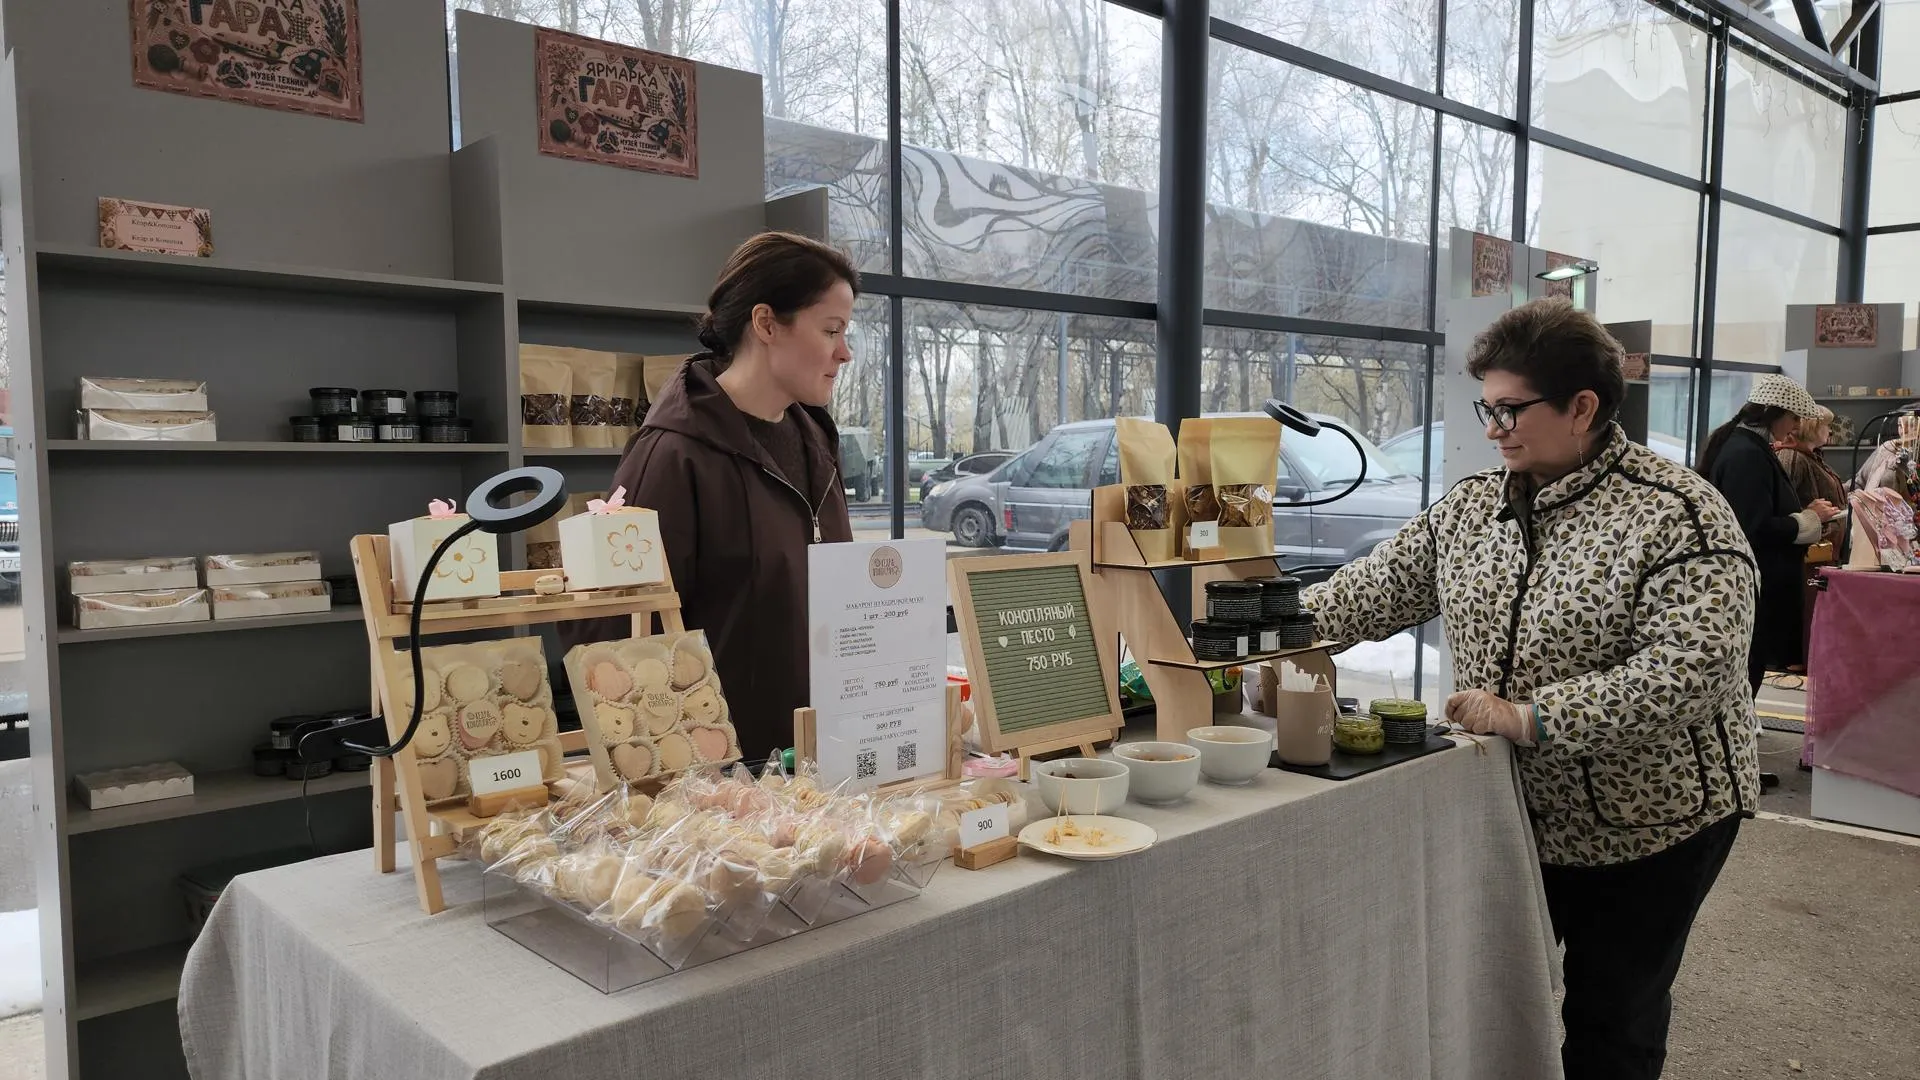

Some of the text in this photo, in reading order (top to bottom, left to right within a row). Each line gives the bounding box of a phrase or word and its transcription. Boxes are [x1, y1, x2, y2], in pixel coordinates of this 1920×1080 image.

[250, 70, 309, 88] МУЗЕЙ ТЕХНИКИ
[586, 61, 659, 90] ЯРМАРКА
[578, 75, 665, 117] ГАРАЖ
[998, 602, 1075, 626] КОНОПЛЯНЫЙ
[1021, 627, 1056, 645] ПЕСТО
[1026, 651, 1073, 671] 750 РУБ
[493, 768, 521, 781] 1600
[977, 818, 993, 831] 900
